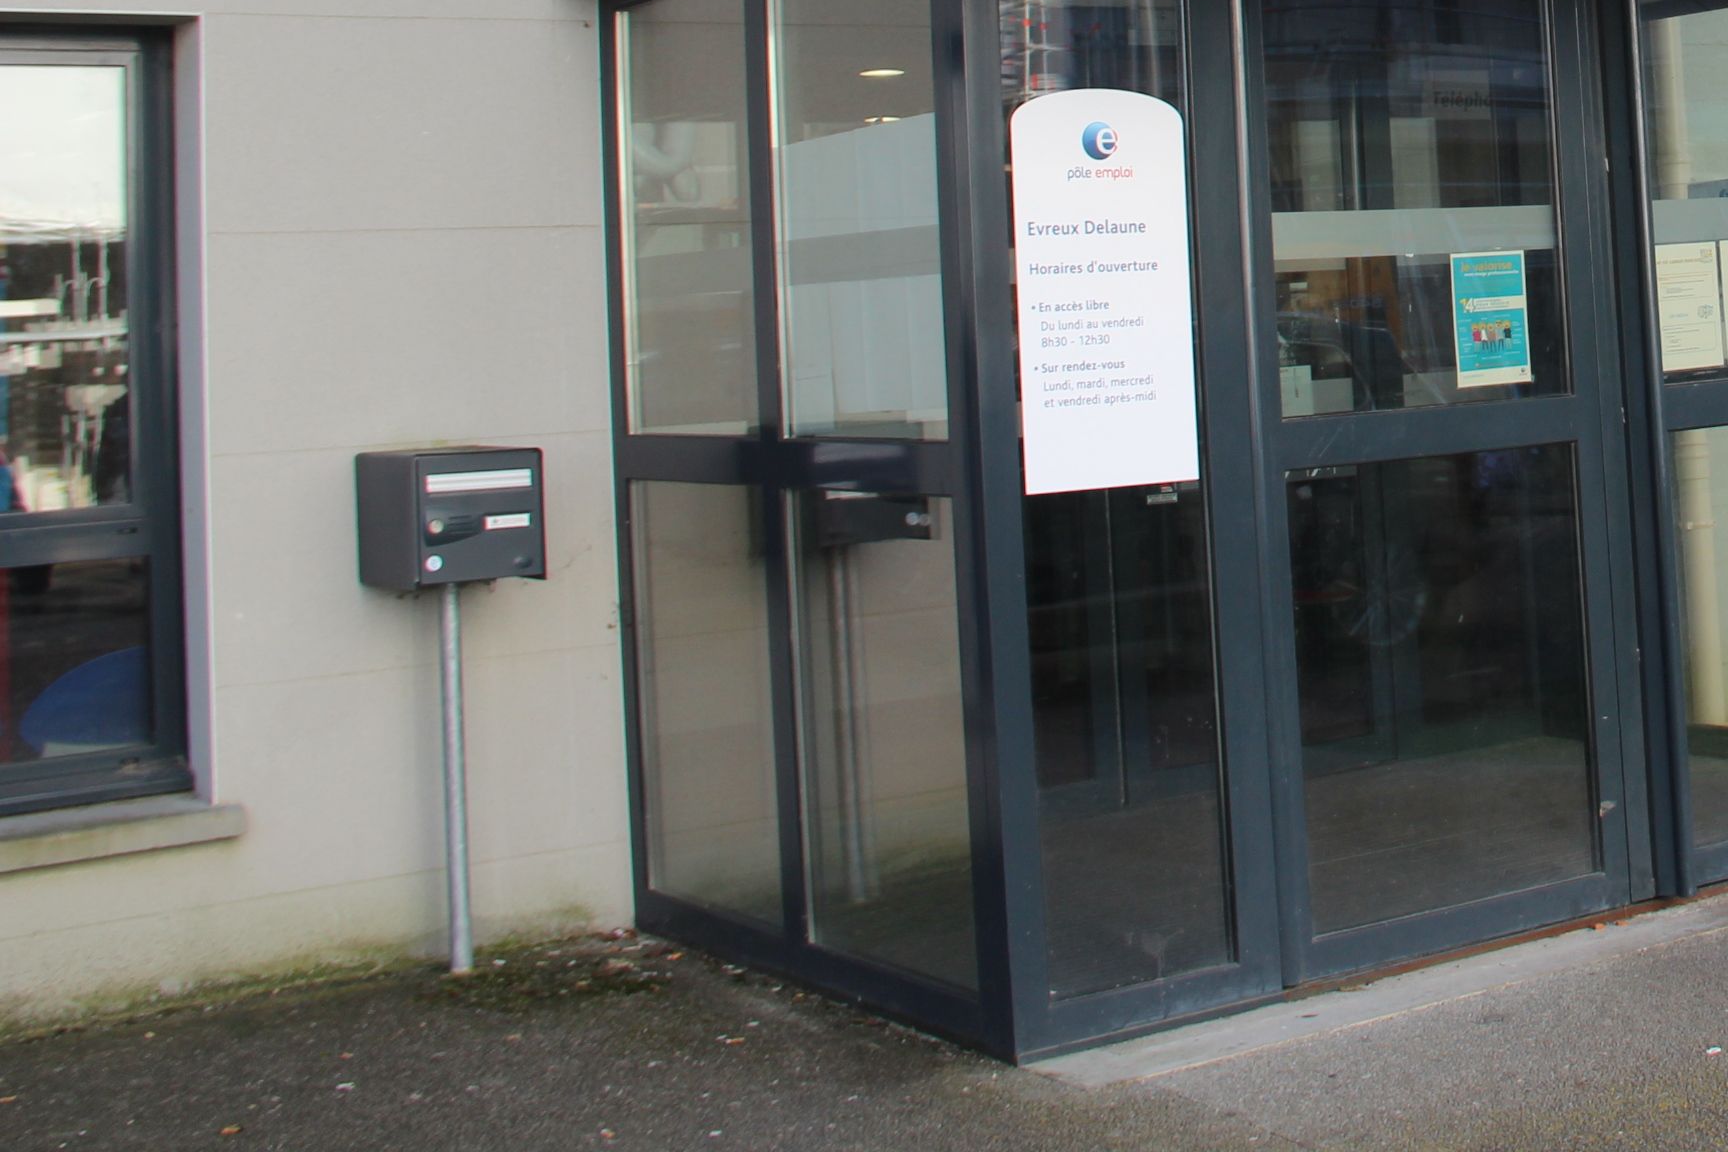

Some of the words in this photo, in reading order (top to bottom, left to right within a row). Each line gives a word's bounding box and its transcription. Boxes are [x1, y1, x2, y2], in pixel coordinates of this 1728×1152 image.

[1066, 166, 1093, 183] pôle
[1095, 165, 1134, 182] emploi
[1027, 221, 1080, 237] Evreux
[1084, 219, 1147, 235] Delaune
[1029, 262, 1084, 276] Horaires
[1086, 260, 1159, 274] d'ouverture
[1038, 302, 1052, 313] En
[1054, 301, 1084, 313] accès
[1085, 299, 1110, 311] libre
[1040, 321, 1056, 332] Du
[1058, 319, 1084, 331] lundi
[1086, 320, 1099, 330] au
[1101, 316, 1145, 329] vendredi
[1041, 336, 1068, 349] 8h30
[1079, 333, 1111, 346] 12h30
[1041, 362, 1059, 374] Sur
[1062, 360, 1126, 373] rendez-vous
[1043, 379, 1074, 393] Lundi,
[1076, 377, 1109, 391] mardi,
[1110, 374, 1155, 388] mercredi
[1043, 398, 1055, 409] et
[1057, 394, 1101, 408] vendredi
[1103, 390, 1157, 407] après-midi
